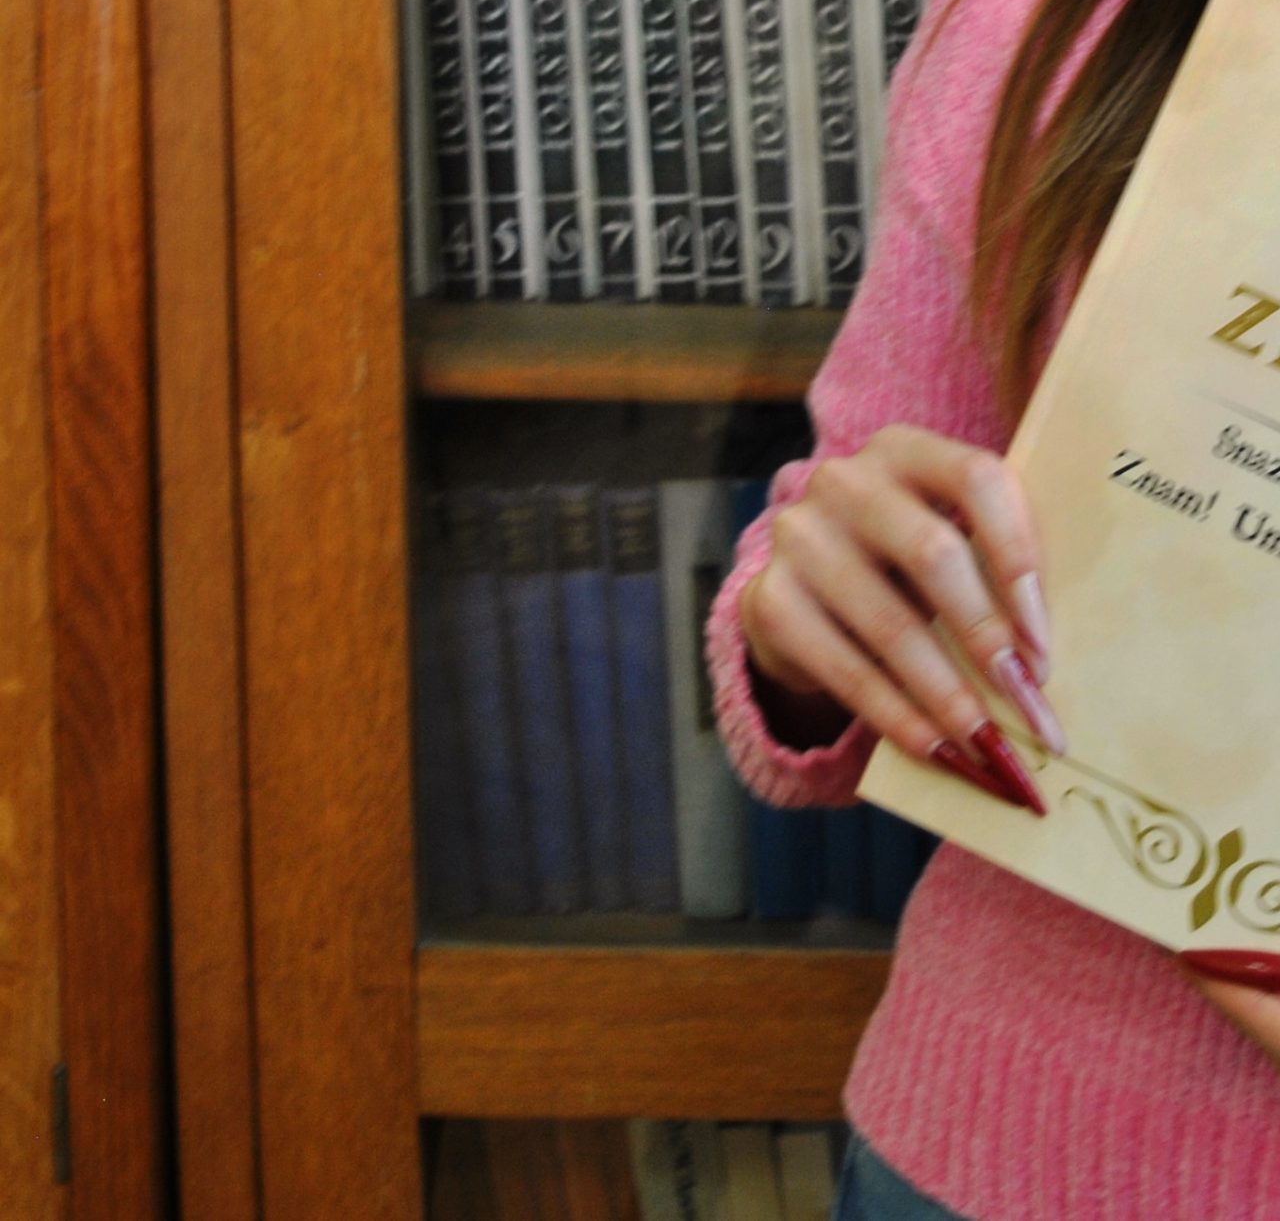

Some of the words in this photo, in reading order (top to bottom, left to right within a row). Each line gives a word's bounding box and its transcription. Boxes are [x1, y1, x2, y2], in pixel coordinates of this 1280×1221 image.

[491, 217, 519, 264] 5
[542, 211, 581, 263] 6
[600, 220, 633, 256] 7
[757, 223, 791, 271] 9
[825, 225, 859, 272] 9
[1108, 449, 1220, 522] Znam!
